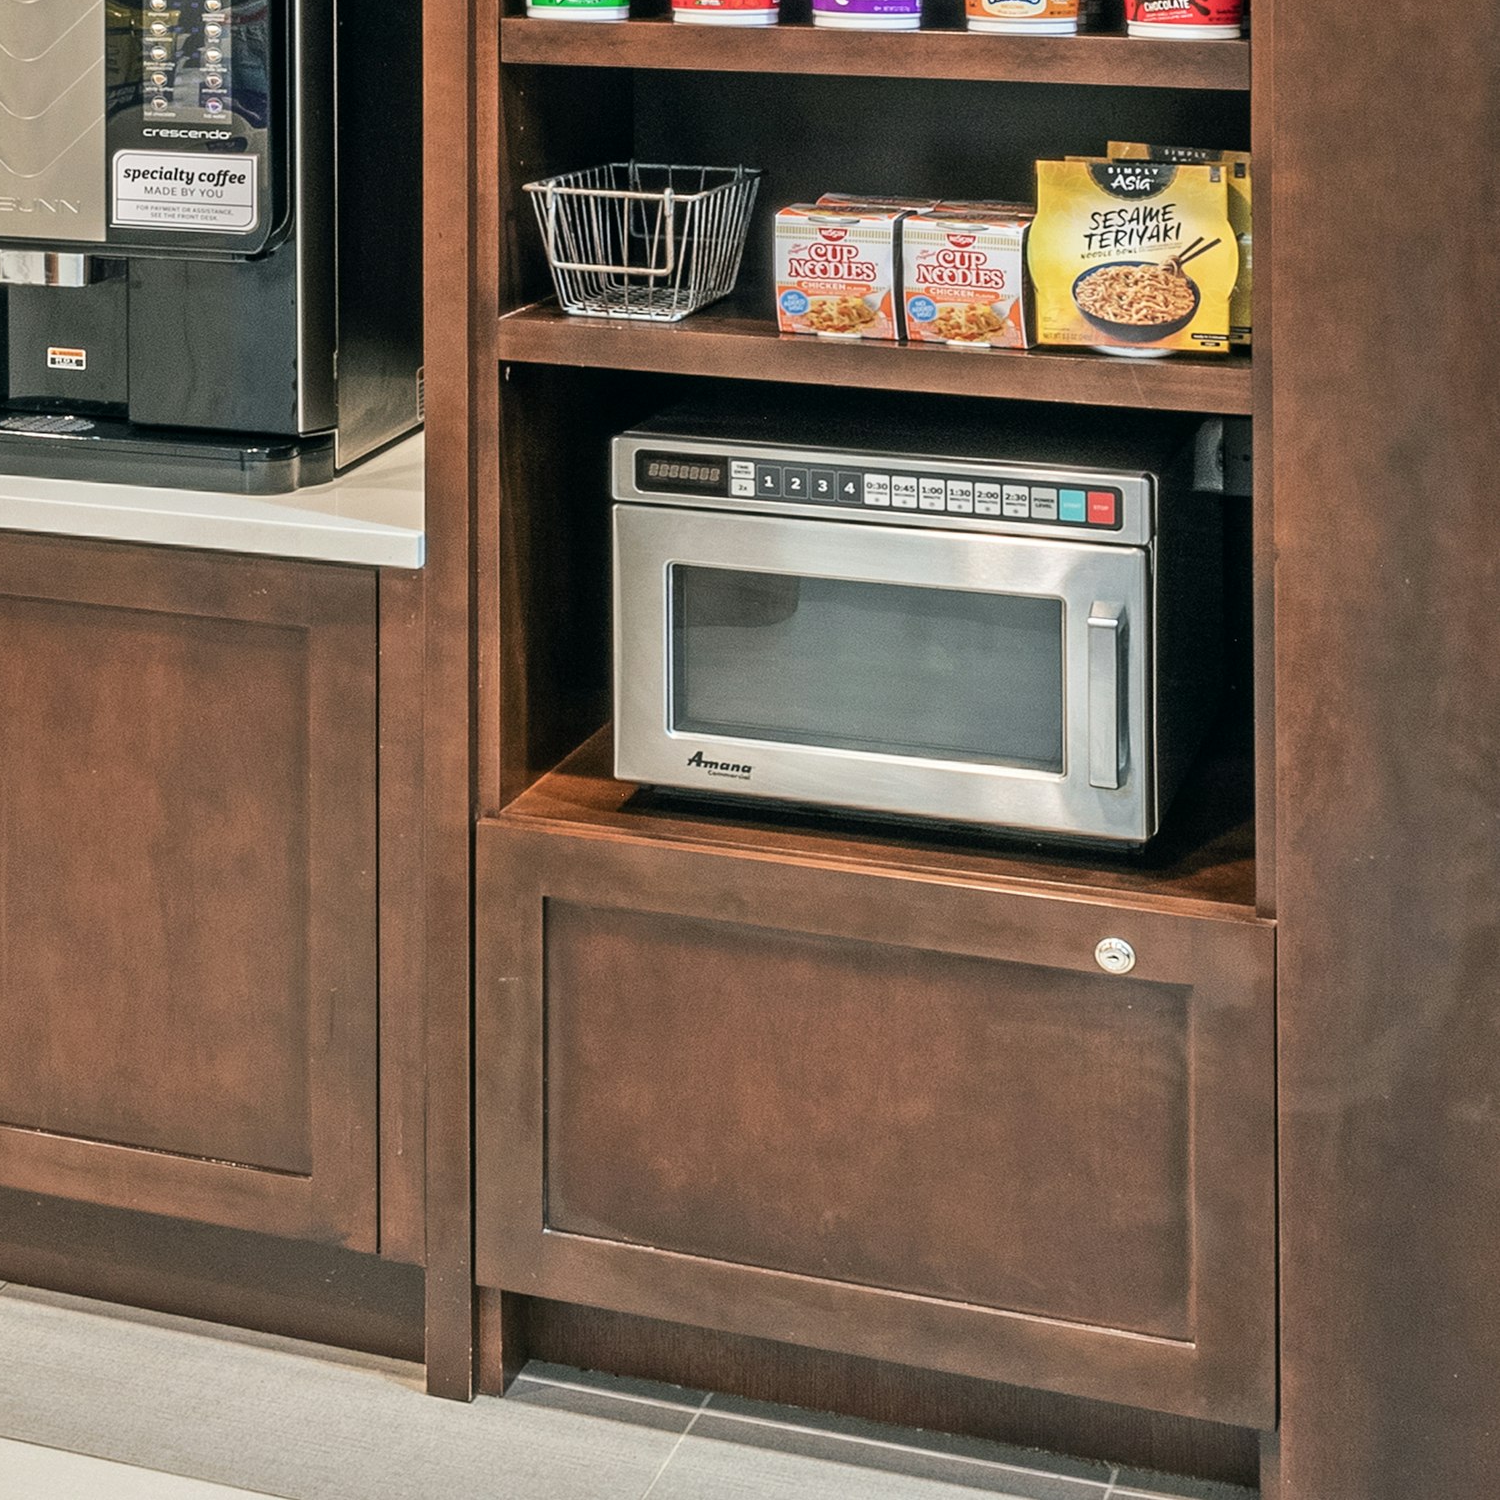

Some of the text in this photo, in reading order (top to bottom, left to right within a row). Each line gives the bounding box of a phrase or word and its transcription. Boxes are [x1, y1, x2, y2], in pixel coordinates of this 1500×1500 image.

[1144, 0, 1190, 11] CHOCOLATE
[143, 128, 230, 140] crescendo
[1164, 149, 1207, 159] SIMPLY
[123, 167, 247, 186] specialty coffee
[1107, 167, 1159, 175] SIMPLY
[1111, 175, 1151, 191] Asia
[144, 186, 224, 198] MADE BY YOU
[1089, 203, 1176, 230] SESAME
[1084, 222, 1182, 250] TERIYAKI
[808, 243, 859, 263] CUP
[1081, 248, 1138, 259] NOODLE BOWL
[937, 249, 987, 269] CUP
[788, 259, 876, 281] NOODLES
[916, 265, 1005, 288] NOODLES
[801, 281, 846, 291] CHICKEN
[929, 287, 974, 297] CHICKEN
[764, 476, 774, 487] 1
[791, 478, 801, 489] 2
[818, 480, 828, 492] 3
[866, 482, 888, 490] 0:30
[844, 482, 855, 494] 4
[893, 484, 915, 492] 0:45
[921, 486, 943, 495] 1:00
[950, 489, 971, 497] 1:30
[977, 491, 999, 499] 2:00
[1005, 493, 1027, 501] 2:30
[687, 751, 753, 773] Amana
